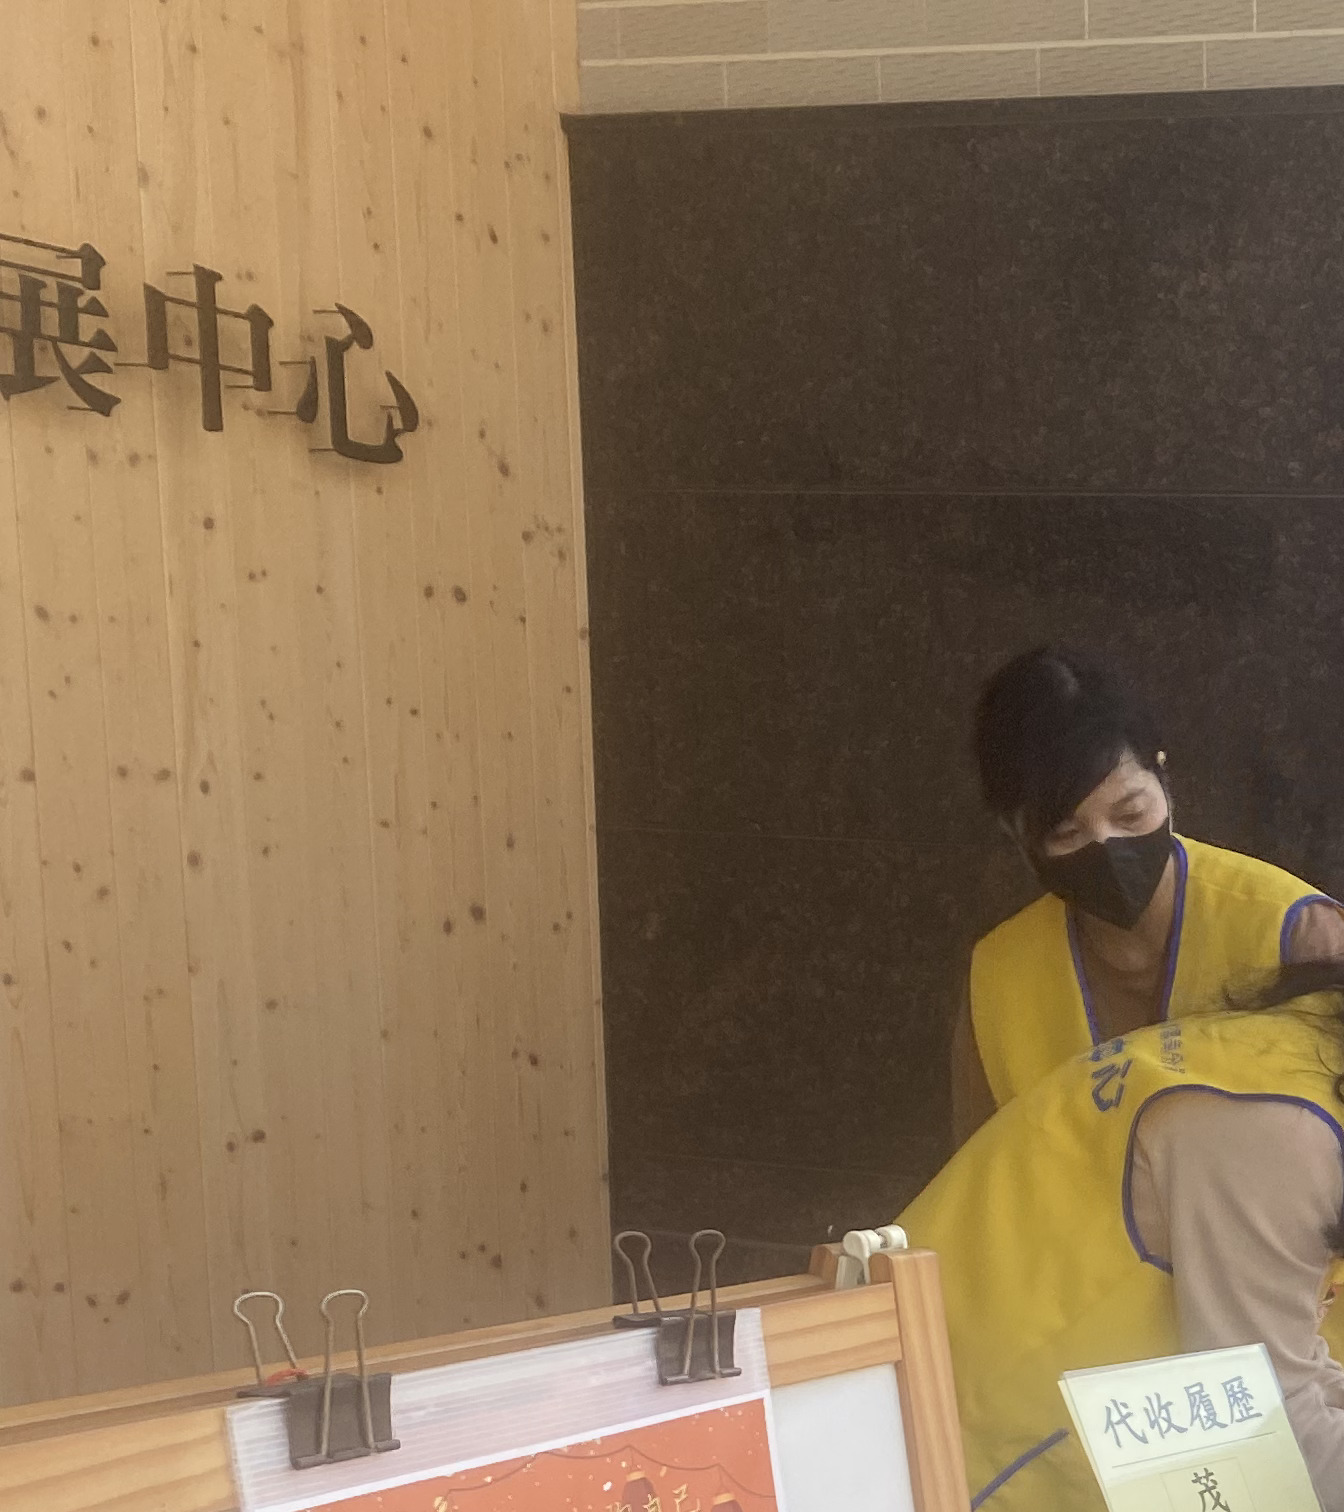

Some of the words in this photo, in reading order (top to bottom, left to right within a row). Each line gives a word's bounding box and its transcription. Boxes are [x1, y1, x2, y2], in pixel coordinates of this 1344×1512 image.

[0, 234, 420, 464] 展中心
[1103, 1375, 1265, 1450] 代收履歷
